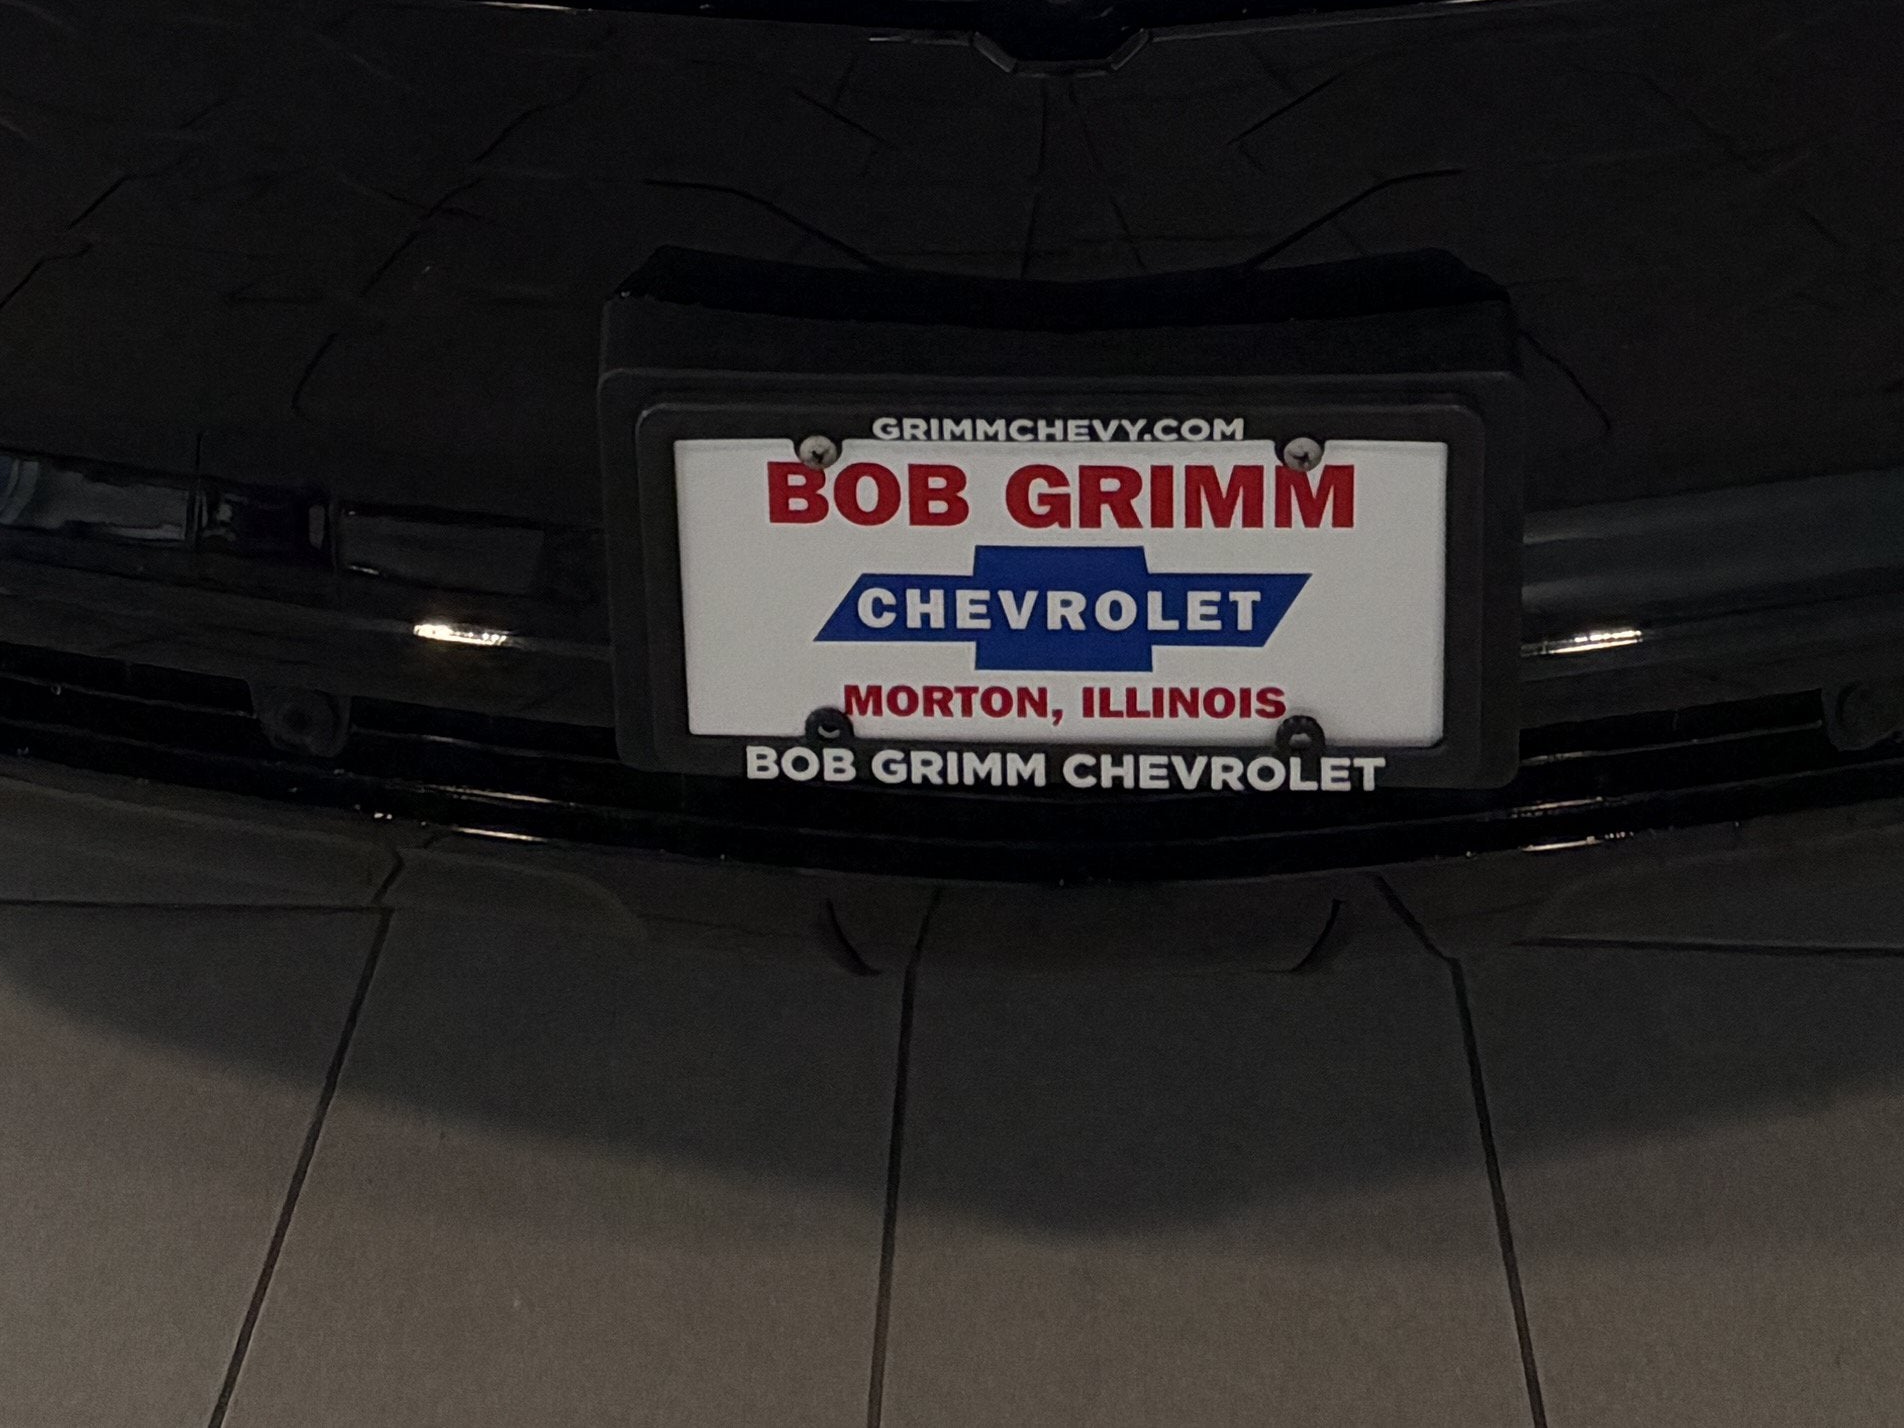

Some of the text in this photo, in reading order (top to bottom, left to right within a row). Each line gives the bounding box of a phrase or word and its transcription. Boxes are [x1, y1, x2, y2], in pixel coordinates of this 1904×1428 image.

[871, 417, 1245, 443] GRIMMCHEVY.COM
[767, 461, 1356, 529] BOB GRIMM
[857, 587, 1262, 631] CHEVROLET
[843, 685, 1287, 726] MORTON, ILLINOIS
[745, 745, 1387, 792] BOB GRIMM CHEVROLET
